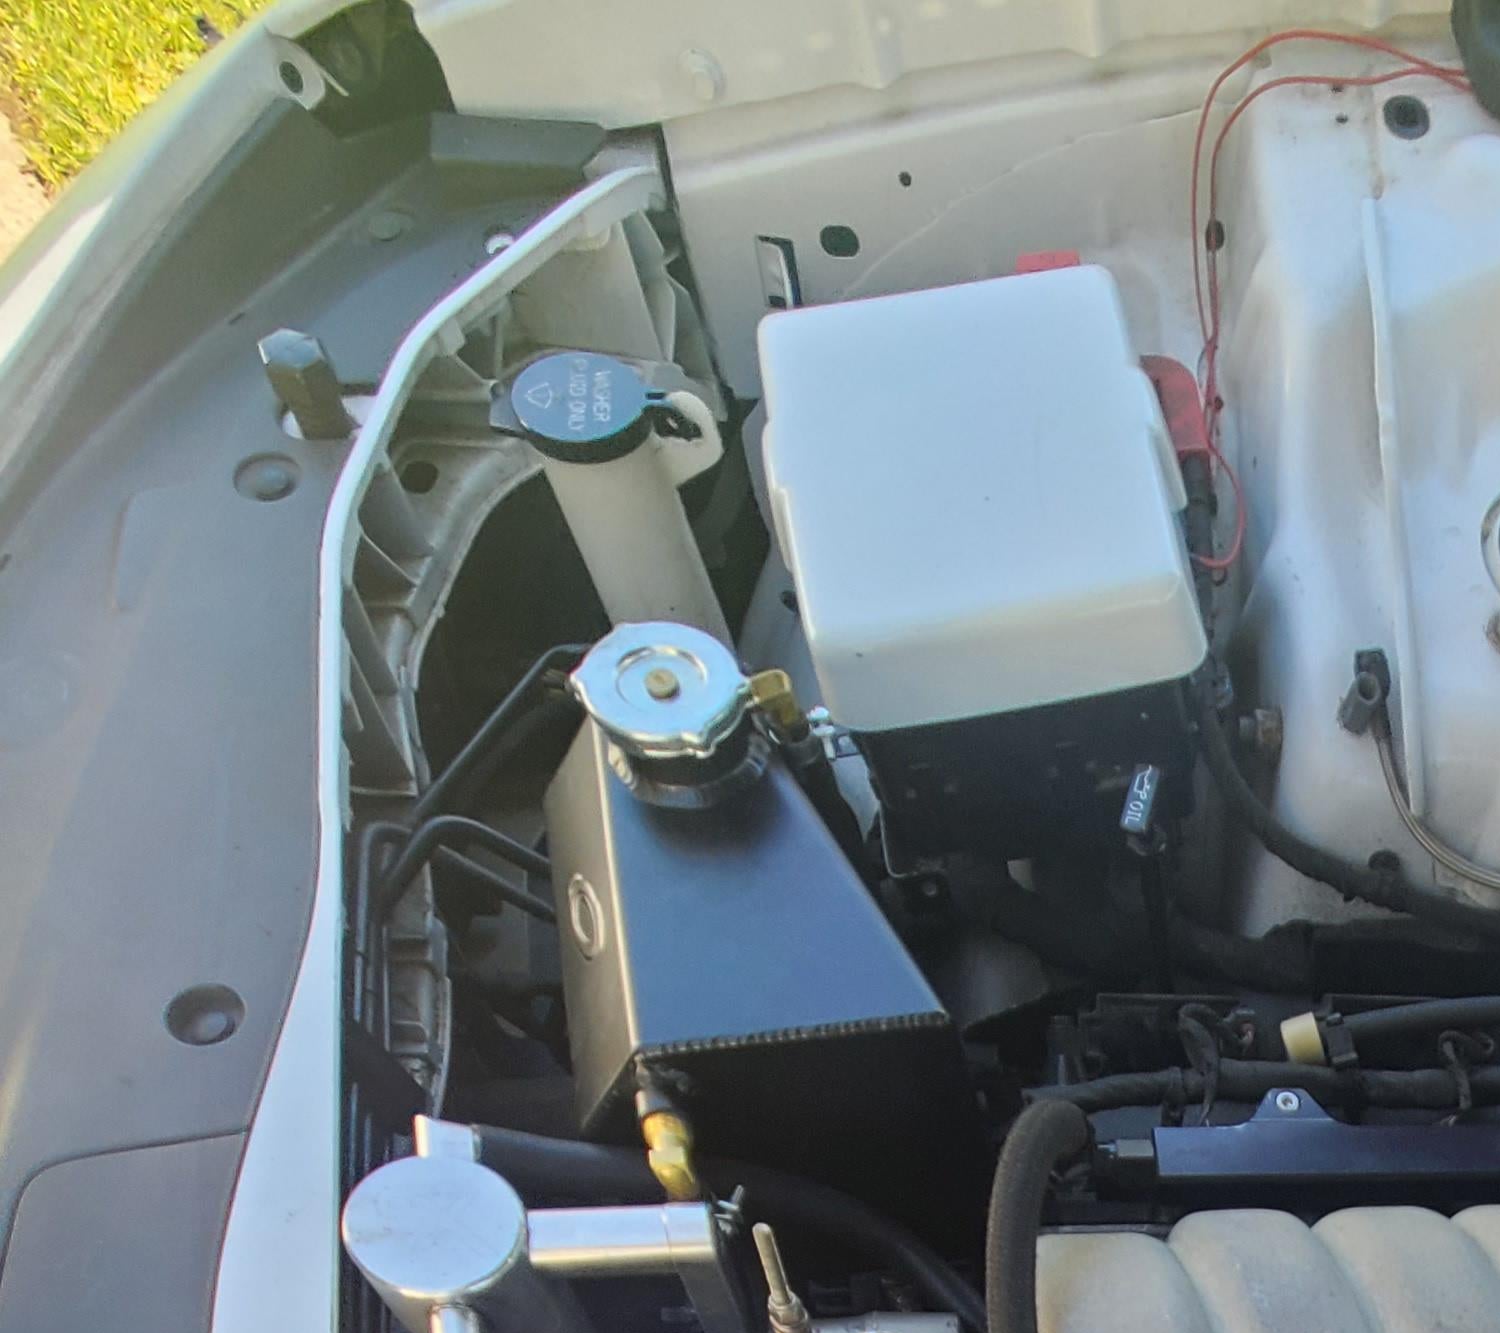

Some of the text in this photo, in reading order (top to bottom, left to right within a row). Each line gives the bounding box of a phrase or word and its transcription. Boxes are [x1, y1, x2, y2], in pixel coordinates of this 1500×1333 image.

[568, 358, 589, 431] FLUID ONLY
[593, 370, 611, 422] WASHER
[1125, 801, 1144, 825] OIL
